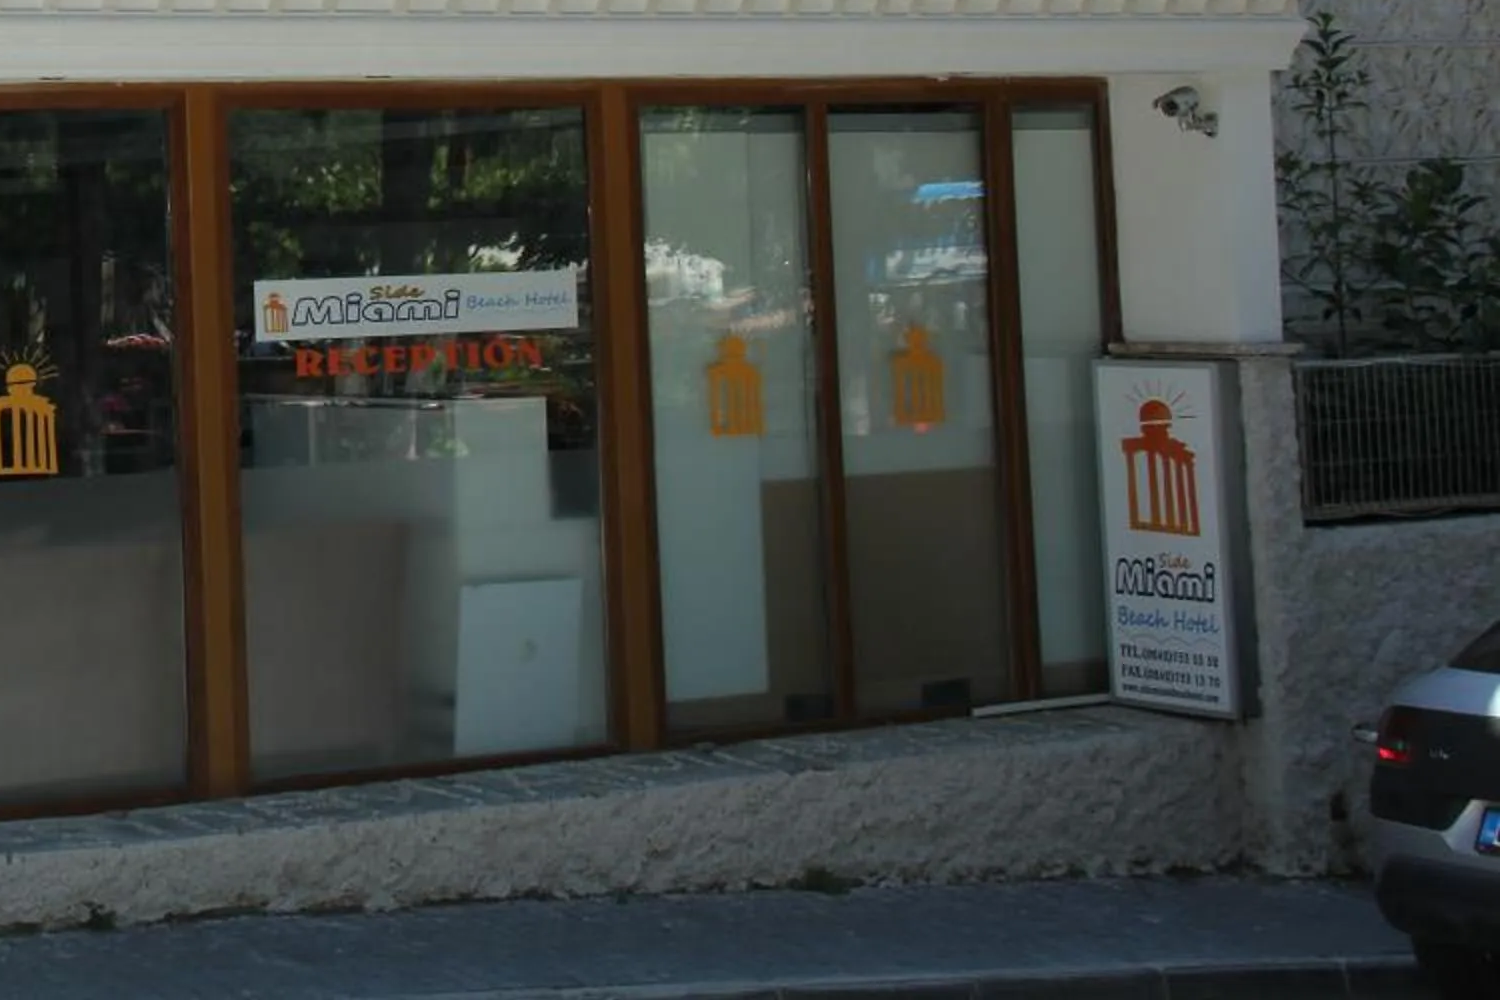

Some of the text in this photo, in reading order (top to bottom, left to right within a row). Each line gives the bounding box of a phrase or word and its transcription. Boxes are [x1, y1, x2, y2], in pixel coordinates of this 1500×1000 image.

[292, 289, 572, 326] Miami Beach Hotel
[369, 286, 425, 301] Side
[294, 336, 543, 378] RECEPTION
[1159, 552, 1193, 570] Side
[1115, 557, 1215, 603] Miami
[1117, 605, 1220, 634] Beach Hotel
